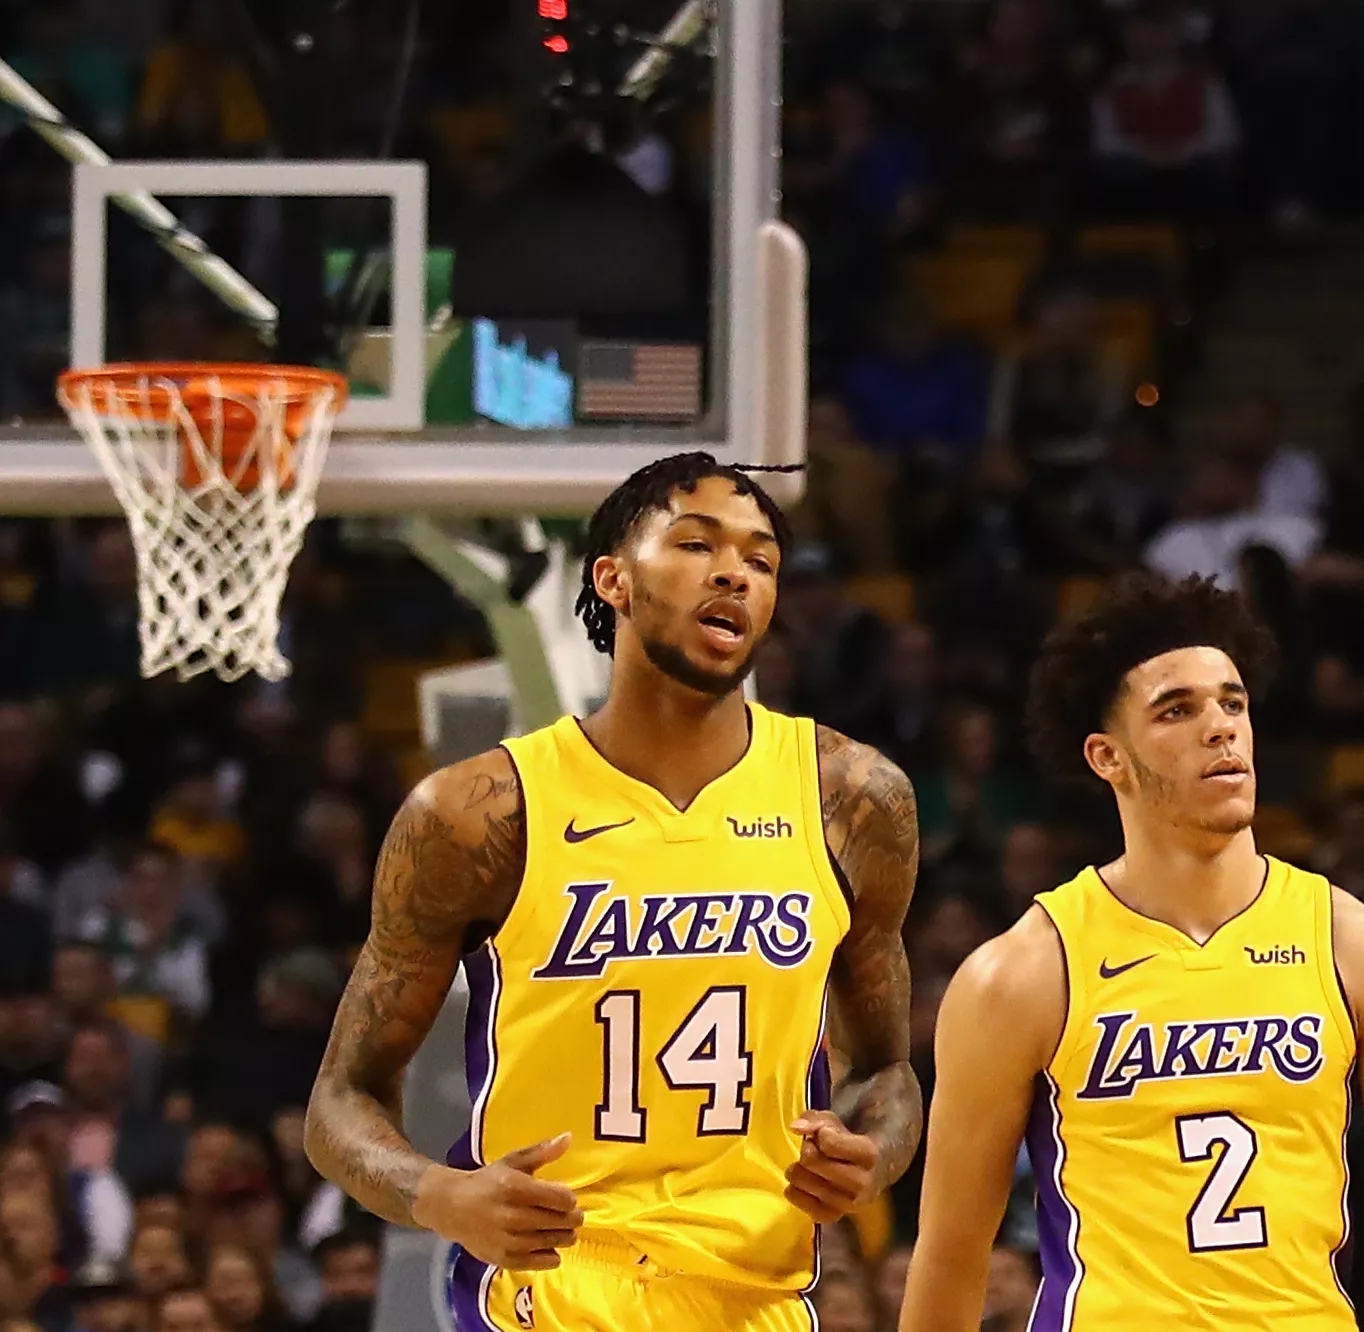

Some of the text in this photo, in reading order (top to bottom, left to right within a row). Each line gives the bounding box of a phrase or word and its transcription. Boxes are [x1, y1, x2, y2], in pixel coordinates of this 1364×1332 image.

[726, 816, 792, 839] wish
[529, 879, 815, 981] LAKERS
[1244, 945, 1306, 966] wish
[594, 985, 753, 1143] 14
[1074, 1010, 1326, 1100] LAKERS
[1175, 1110, 1268, 1254] 2
